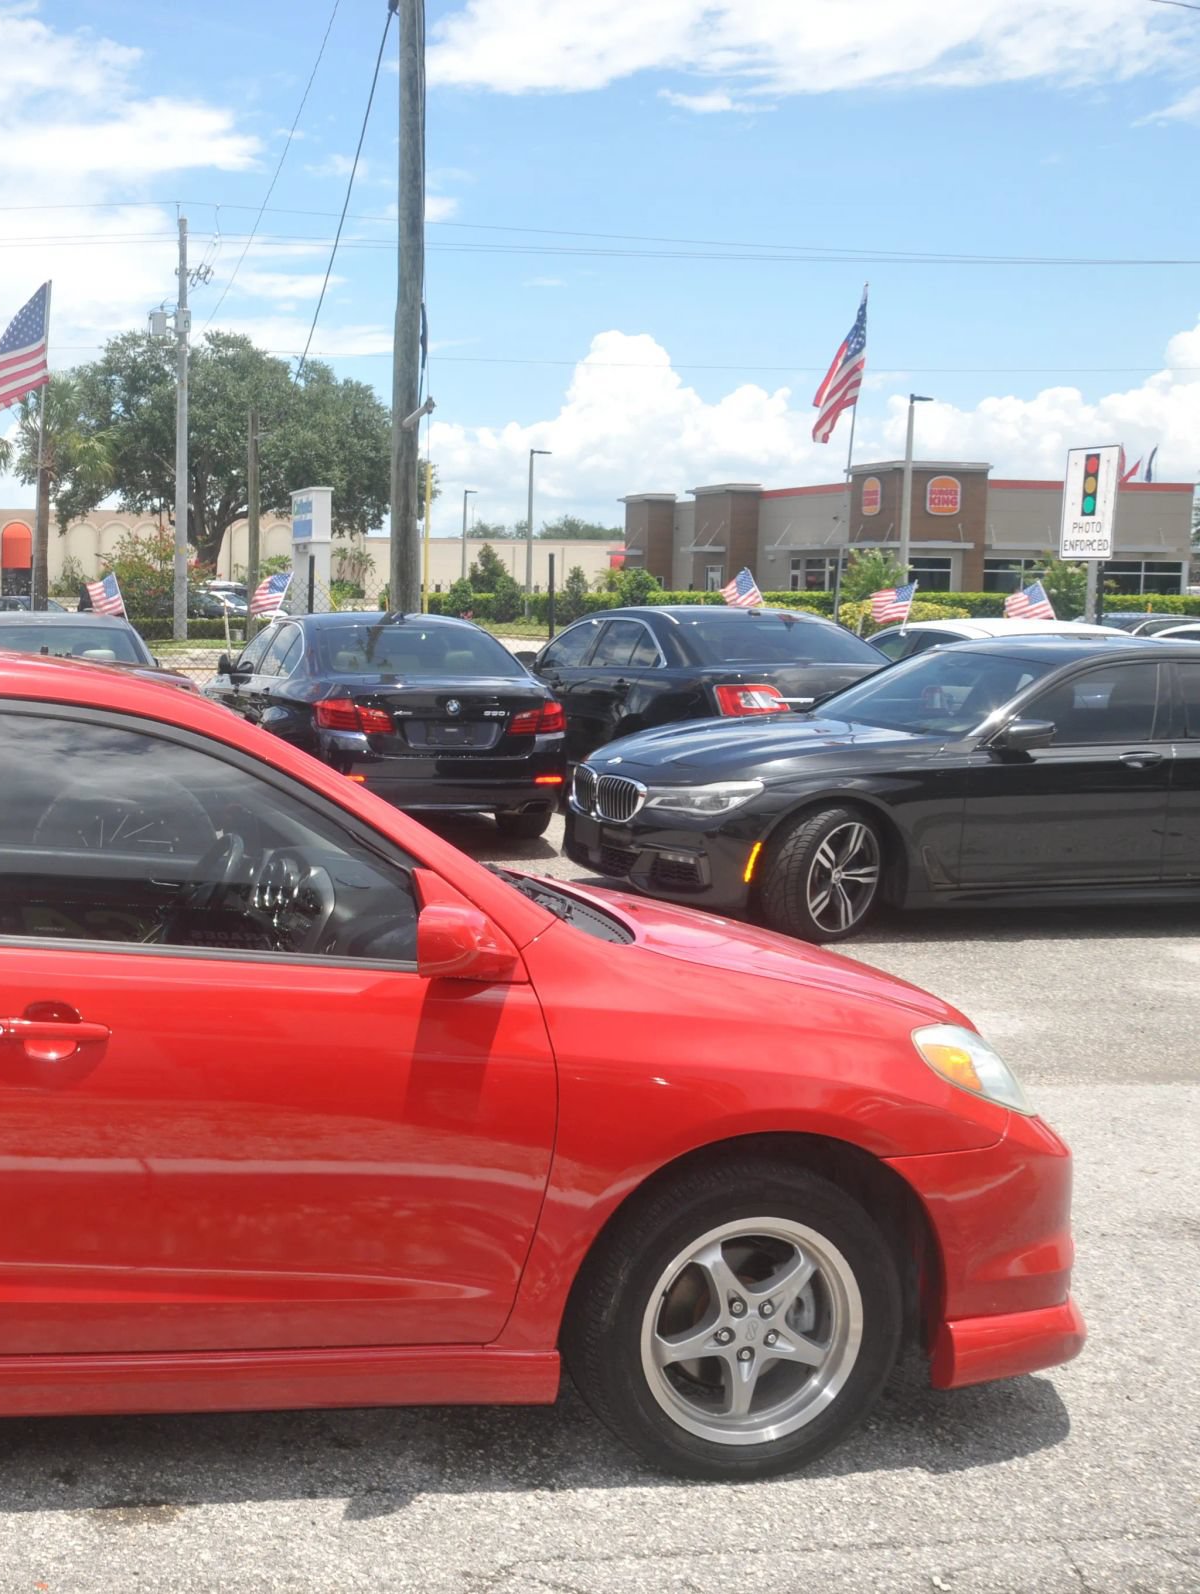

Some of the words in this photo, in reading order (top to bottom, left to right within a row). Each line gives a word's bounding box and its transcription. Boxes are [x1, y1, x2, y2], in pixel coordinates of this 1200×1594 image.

[929, 488, 958, 496] BURGER
[929, 496, 958, 506] KING
[1072, 521, 1102, 533] PHOTO
[1063, 539, 1109, 551] ENFORCED
